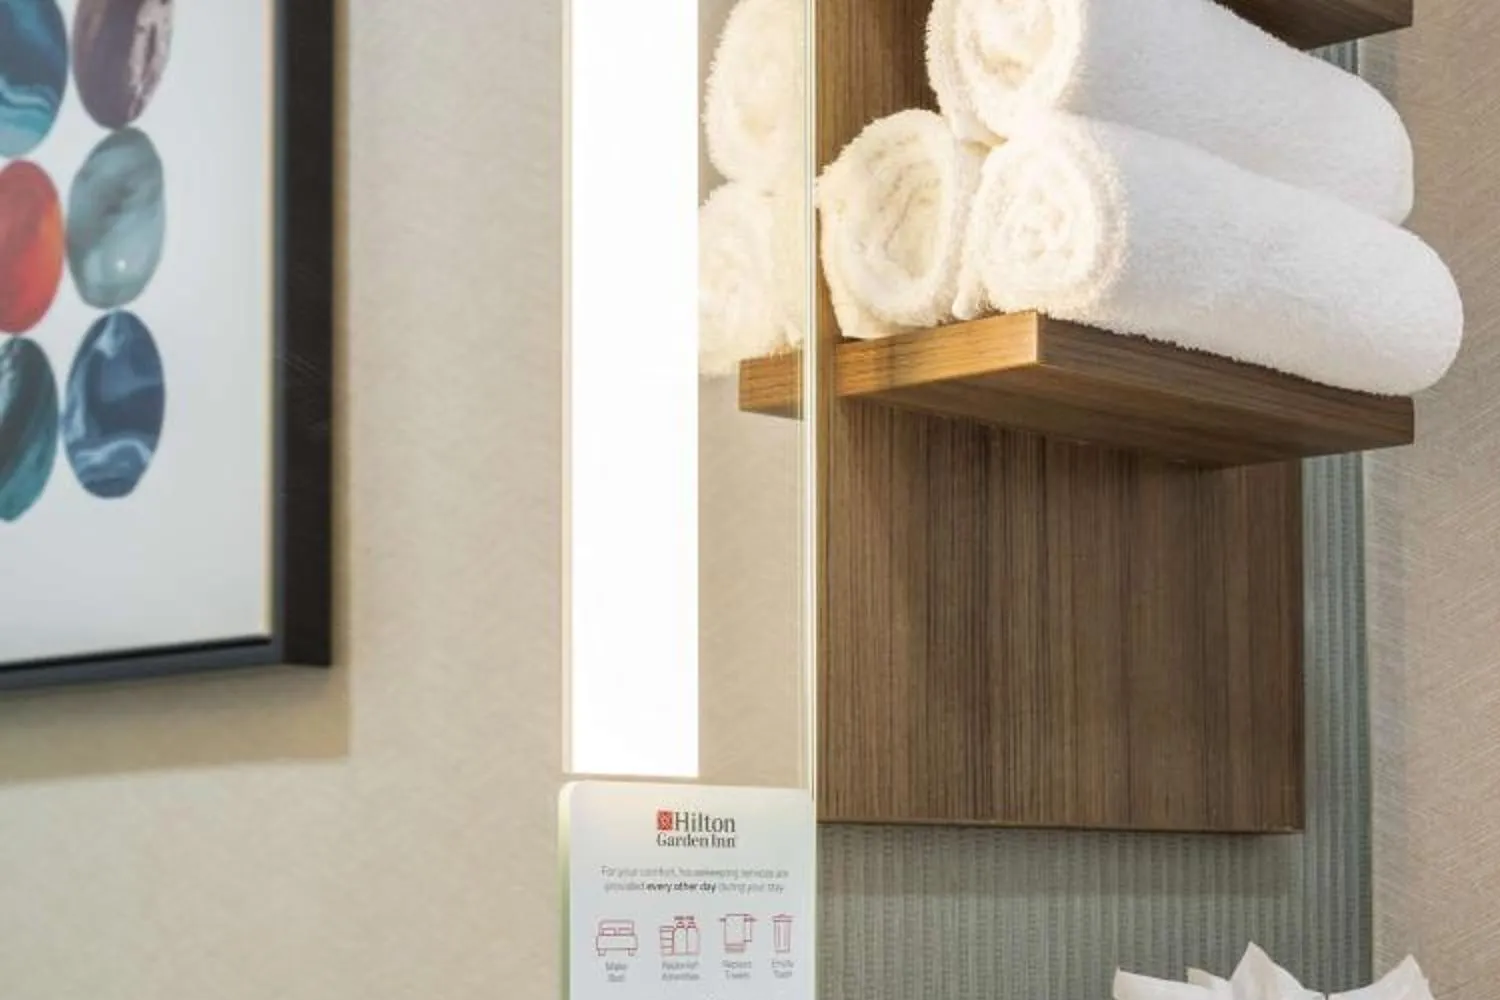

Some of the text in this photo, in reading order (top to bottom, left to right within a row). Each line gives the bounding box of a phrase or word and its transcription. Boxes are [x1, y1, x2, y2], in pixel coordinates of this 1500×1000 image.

[674, 811, 736, 833] Hilton
[656, 832, 736, 849] Garden Inn
[645, 883, 672, 893] every
[674, 881, 698, 892] other
[700, 882, 716, 894] day
